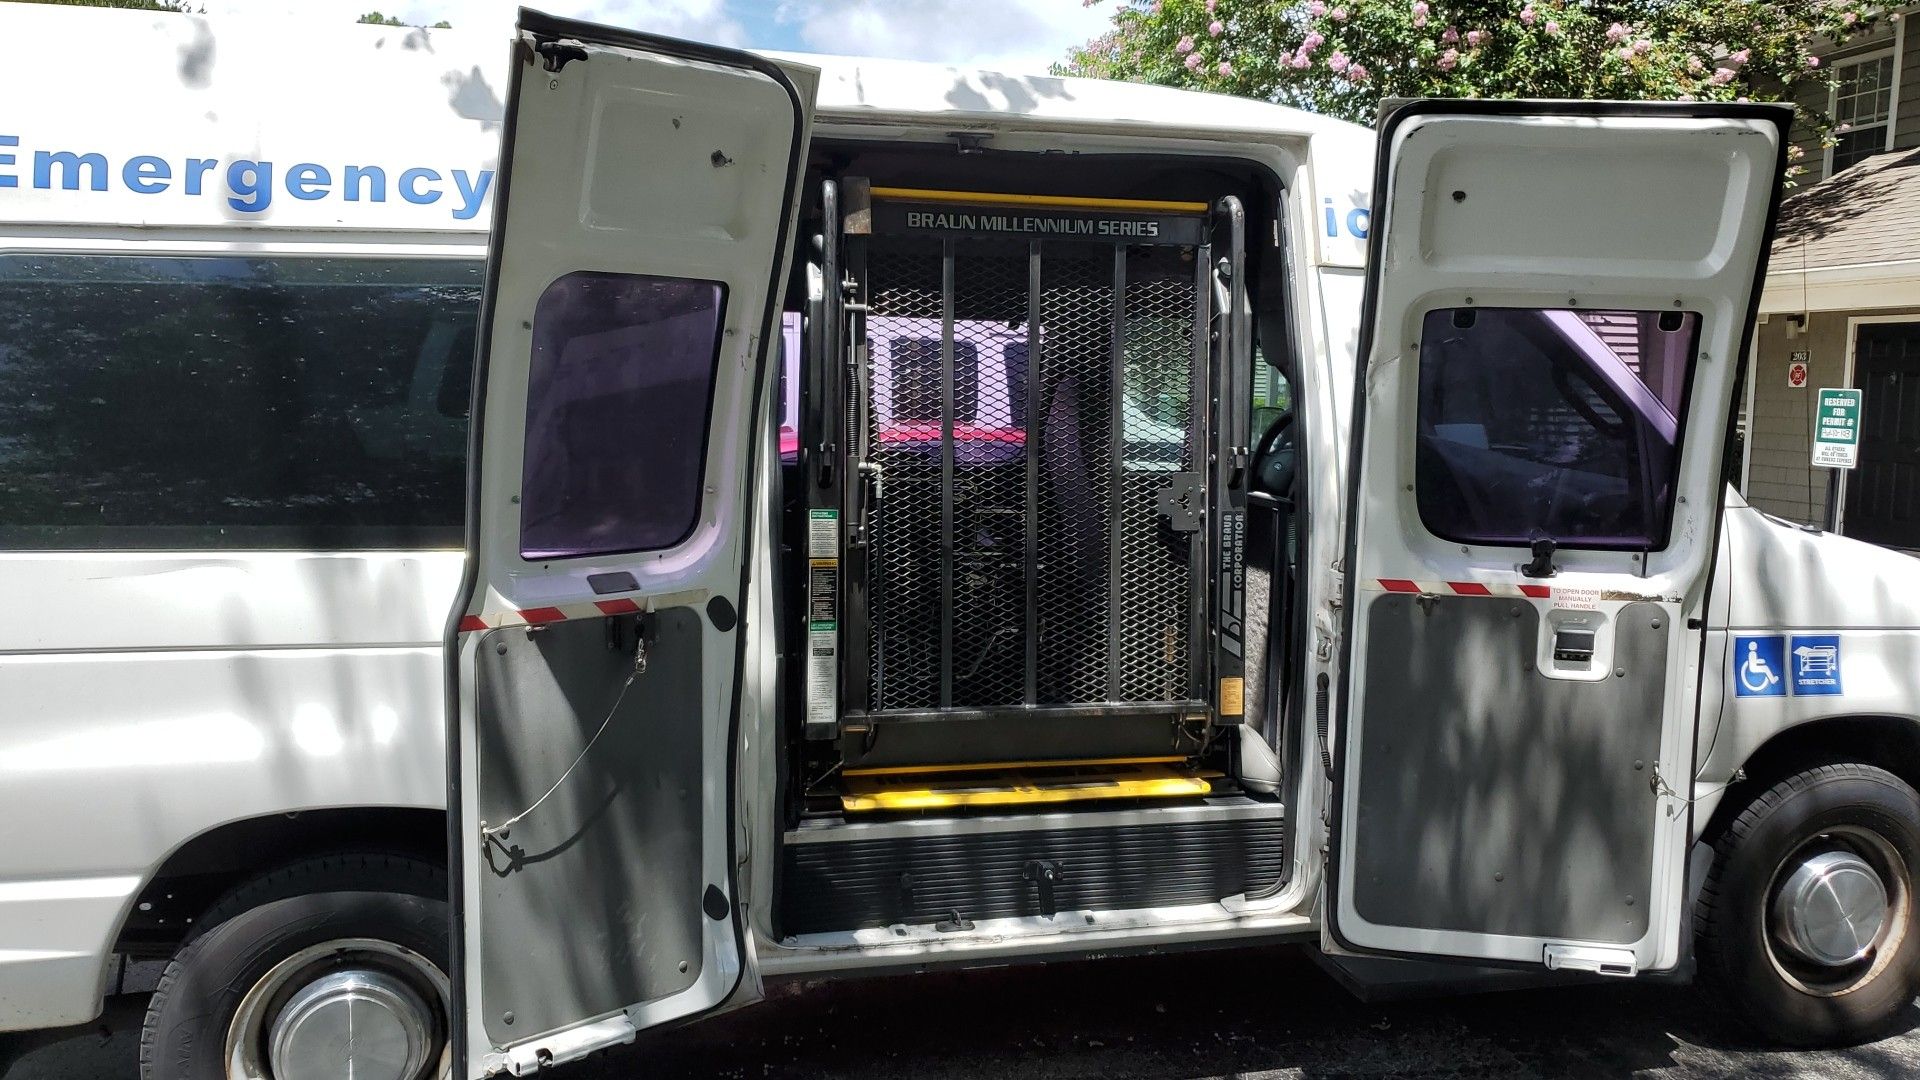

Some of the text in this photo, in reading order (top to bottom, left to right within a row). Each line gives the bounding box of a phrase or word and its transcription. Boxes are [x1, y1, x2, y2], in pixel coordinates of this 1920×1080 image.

[907, 212, 1159, 237] BRAUN MILLENNIUM SERIES
[1825, 398, 1855, 407] RESERVED
[1833, 408, 1846, 416] FOR
[1823, 417, 1855, 427] PERMIT #
[1222, 514, 1232, 569] THE BRAUN
[1233, 514, 1244, 589] CORPORATION
